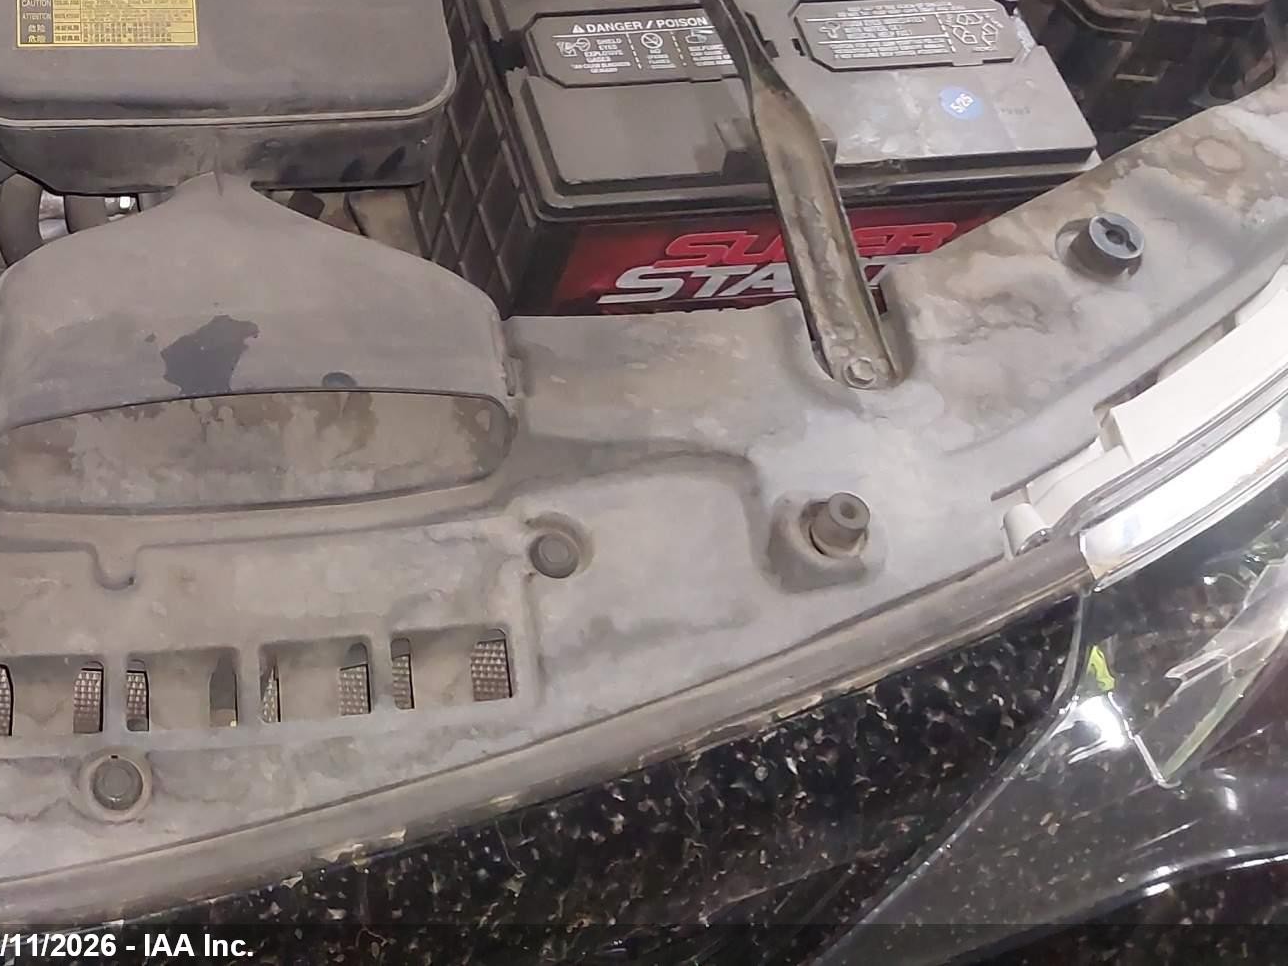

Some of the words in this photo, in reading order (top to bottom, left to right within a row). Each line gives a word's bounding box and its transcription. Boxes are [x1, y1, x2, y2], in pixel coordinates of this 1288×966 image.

[21, 0, 52, 8] CAUTION
[22, 12, 52, 21] ATTENTION
[586, 20, 643, 33] DANGER
[656, 16, 709, 29] POISON
[654, 222, 958, 268] SUER
[597, 254, 928, 304] STAT
